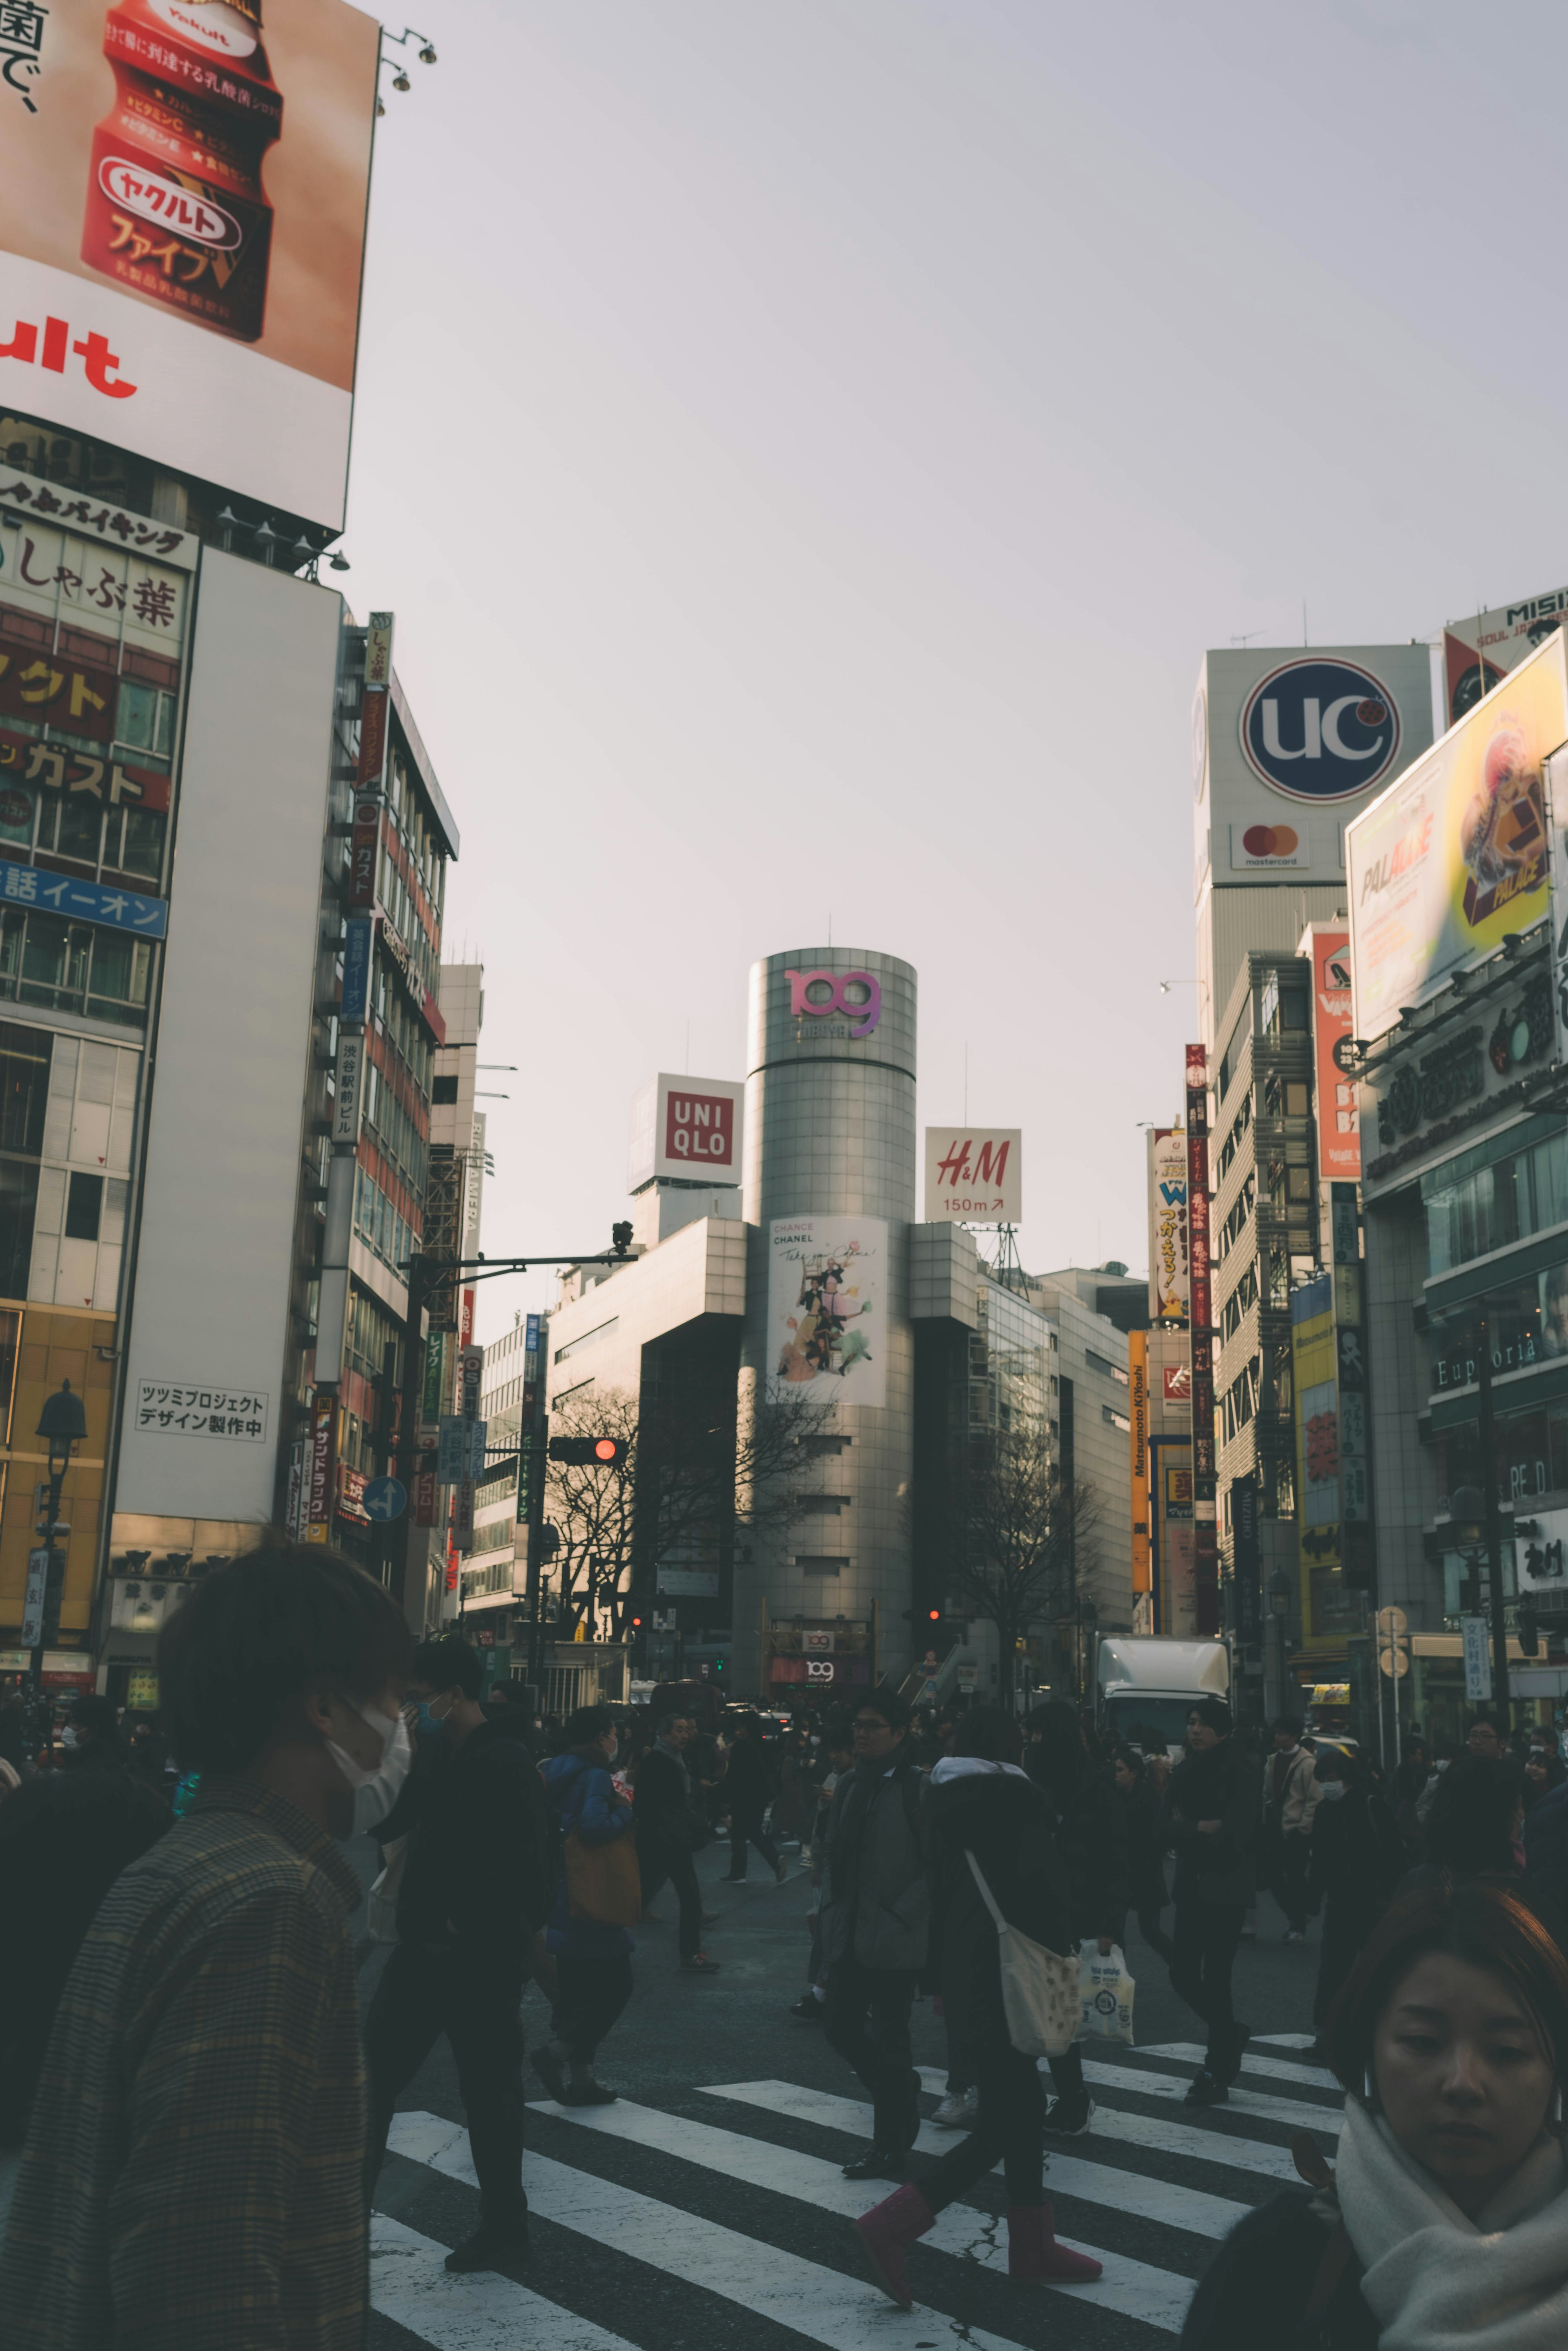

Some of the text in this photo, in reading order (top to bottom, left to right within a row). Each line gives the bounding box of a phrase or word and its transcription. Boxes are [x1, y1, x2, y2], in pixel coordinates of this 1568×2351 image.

[168, 6, 230, 47] Yakult
[120, 172, 216, 233] ヤクルト
[108, 213, 218, 282] ファイブ
[20, 536, 176, 627] しゃぶ葉
[1507, 590, 1568, 626] MISI
[25, 742, 143, 804] ガスト
[356, 846, 374, 895] ガスト
[1245, 856, 1298, 867] mastercard
[0, 865, 159, 926] 話イーオン
[348, 928, 366, 1012] 英会話イーオン
[784, 969, 881, 1038] 109
[338, 1045, 358, 1134] 渋谷駅前ビル
[674, 1099, 722, 1130] UNI
[673, 1129, 726, 1157] QLO
[937, 1139, 1011, 1188] H&M
[774, 1222, 813, 1233] CHANCE
[943, 1197, 988, 1212] 150m
[773, 1234, 813, 1245] CHANEL
[1159, 1208, 1178, 1289] つかえる!
[1437, 1336, 1536, 1387] Euporia
[139, 1407, 262, 1437] デザイン製作中
[142, 1385, 263, 1413] ツツミプロジェクト
[449, 1421, 463, 1479] 渋谷駅前
[471, 1424, 483, 1478] スクランブル式
[1134, 1410, 1144, 1478] Matsumoto
[311, 1431, 329, 1513] サンドラッグ
[419, 1473, 434, 1506] アコム
[298, 1501, 309, 1542] マイアミ
[1241, 1491, 1252, 1539] MIZUHO
[24, 1557, 41, 1639] 道玄坂
[806, 1635, 830, 1650] 109
[1466, 1623, 1480, 1687] 文化村通り
[806, 1661, 834, 1682] 109
